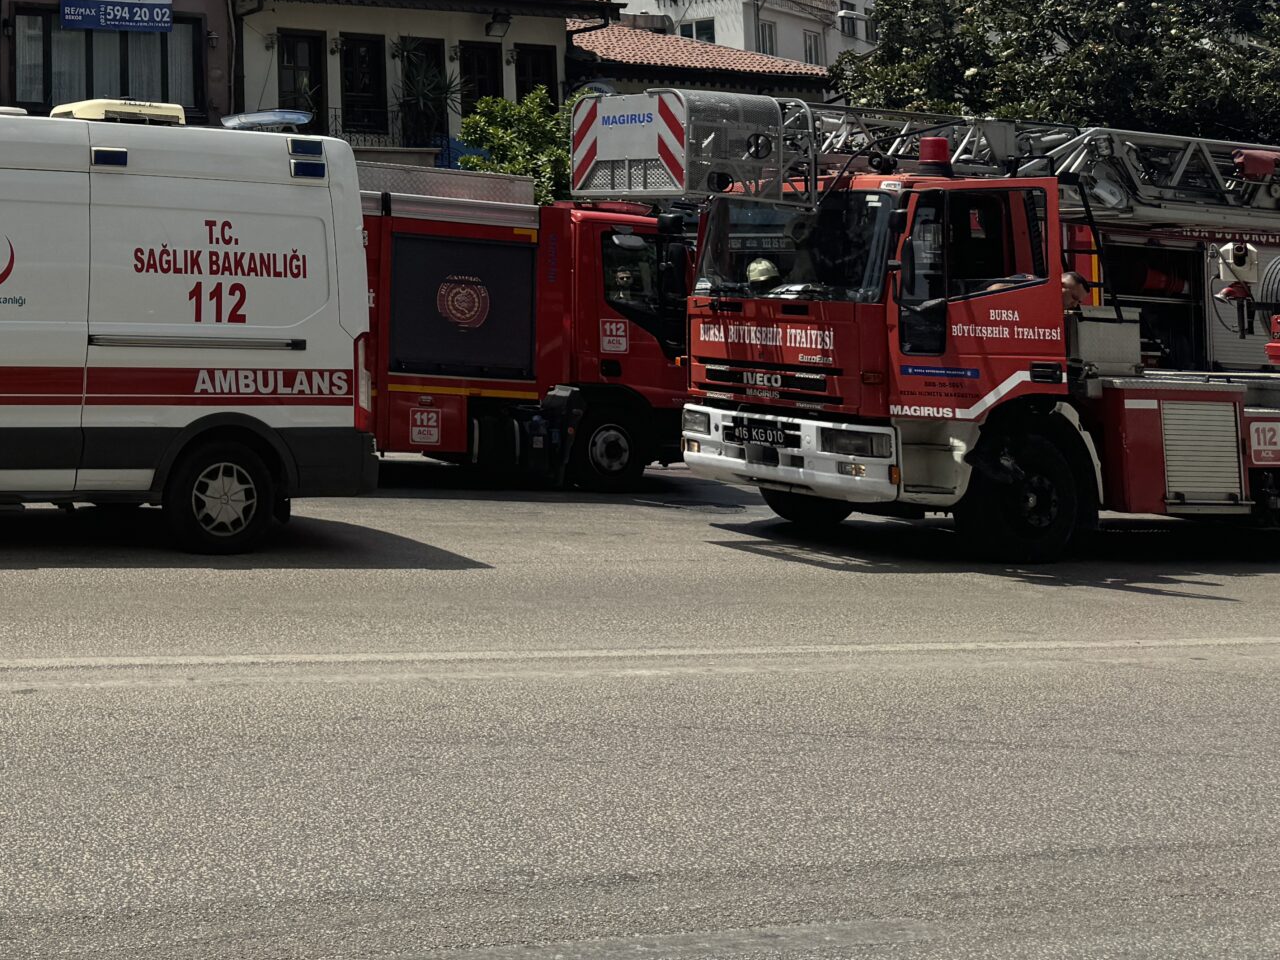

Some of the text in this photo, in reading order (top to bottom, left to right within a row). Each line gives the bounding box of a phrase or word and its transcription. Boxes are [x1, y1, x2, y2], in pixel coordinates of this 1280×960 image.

[64, 7, 96, 16] RE/MAX
[106, 6, 129, 20] 594
[133, 7, 149, 21] 20
[153, 8, 170, 22] 02
[601, 112, 654, 126] MAGIRUS
[205, 219, 239, 246] T.C.
[133, 243, 307, 280] SAĞLIK BAKANLIĞI
[188, 281, 247, 324] 112
[989, 310, 1020, 322] BURSA
[604, 322, 626, 336] 112
[699, 322, 834, 350] BURSA BÜYÜKŞEHİR İTFAİYESİ
[951, 324, 1062, 341] BÜYÜKŞEHİR İTFAİYESİ
[193, 369, 348, 395] AMBULANS
[742, 372, 782, 387] IVECO
[746, 388, 780, 399] MAGIRUS
[414, 412, 438, 426] 112
[889, 404, 953, 418] MAGIRUS
[739, 427, 784, 443] 16 KG 010
[1255, 426, 1278, 446] 112
